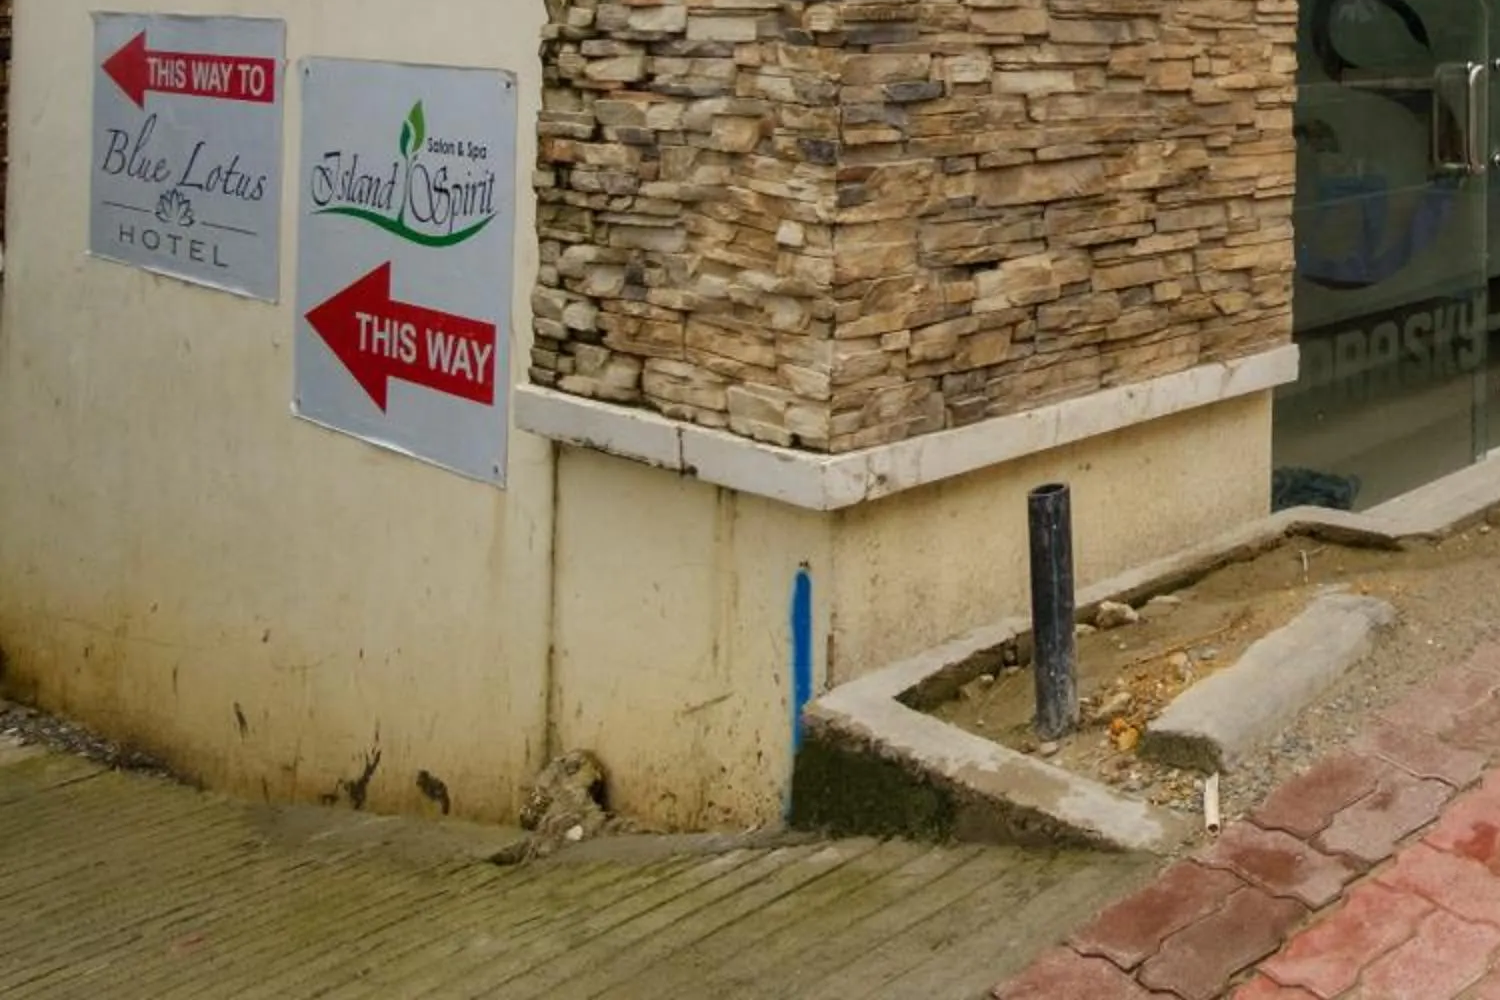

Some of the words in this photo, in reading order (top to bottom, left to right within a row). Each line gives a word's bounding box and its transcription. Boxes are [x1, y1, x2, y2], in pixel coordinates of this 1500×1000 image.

[146, 57, 187, 90] THIS
[191, 60, 233, 93] WAY
[237, 64, 265, 97] TO
[102, 113, 170, 182] Blue
[176, 140, 268, 201] Lotus
[427, 137, 455, 156] Salon
[457, 142, 464, 157] &
[467, 141, 487, 162] Spa
[311, 151, 399, 211] Island
[409, 162, 496, 233] Spirit
[119, 223, 229, 268] HOTEL
[355, 311, 418, 365] THIS
[426, 327, 493, 384] WAY
